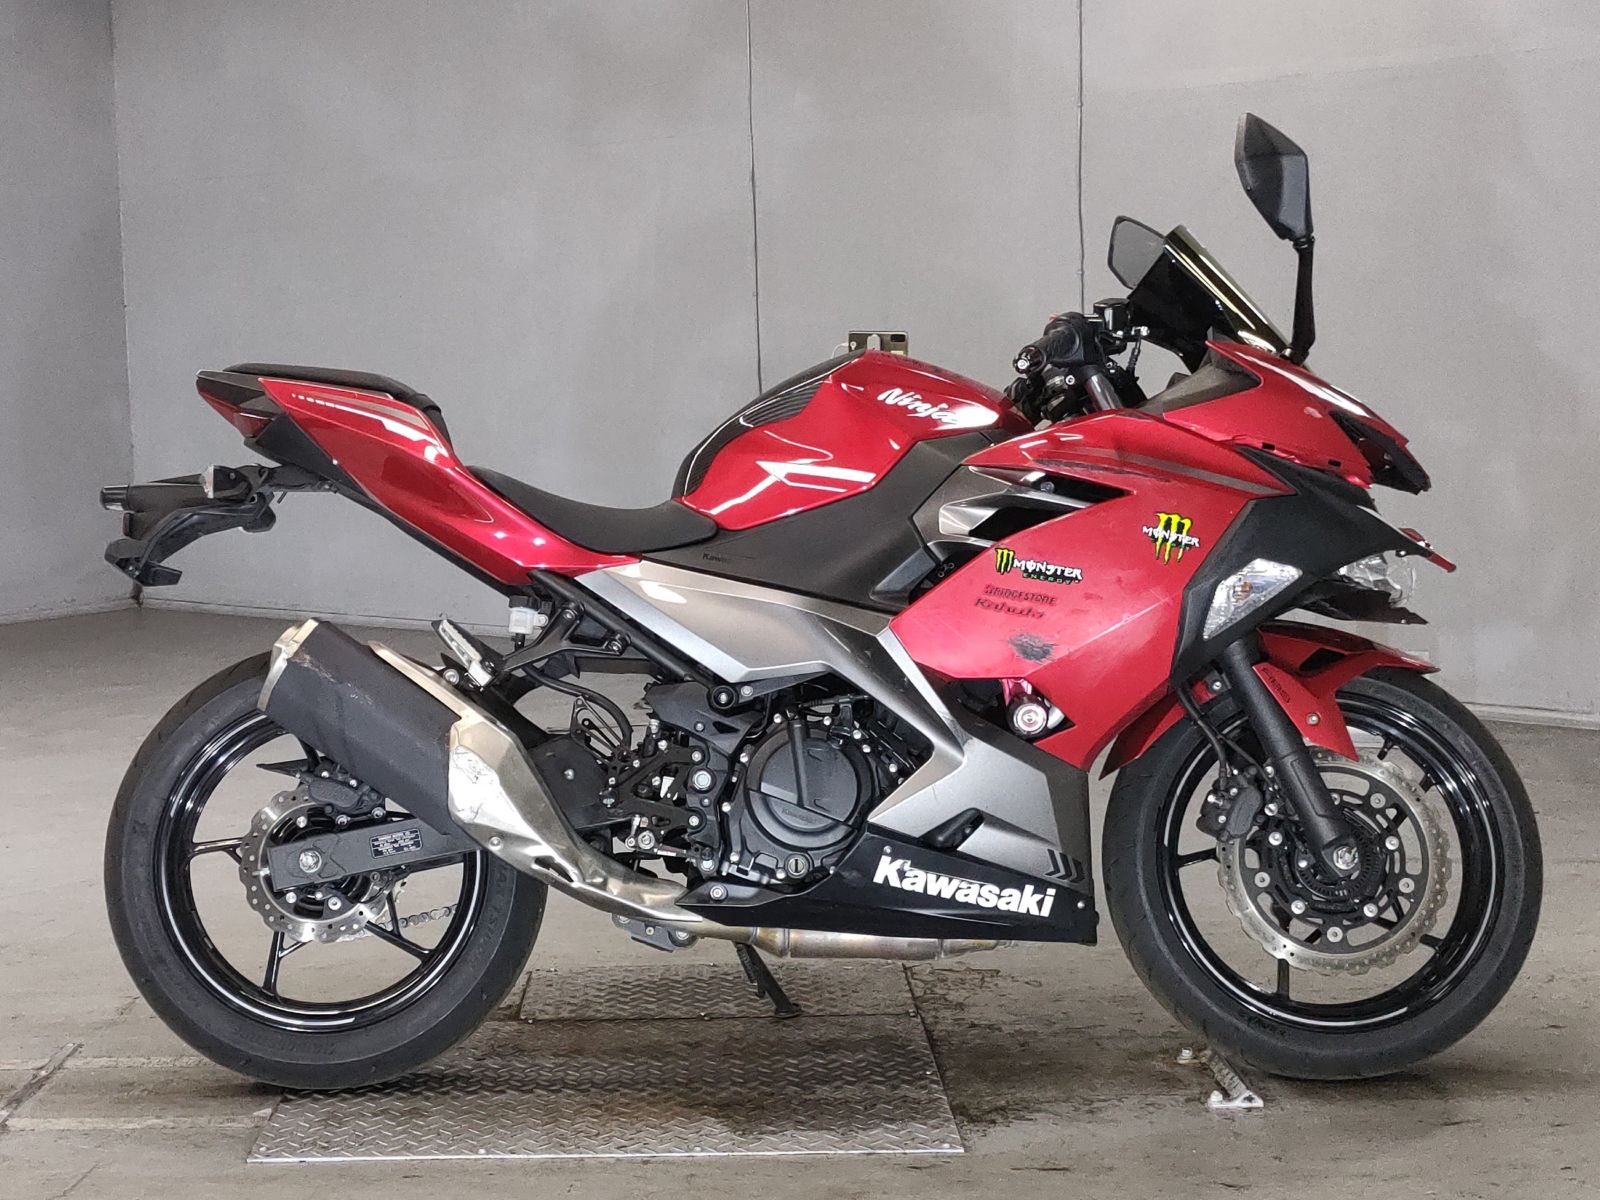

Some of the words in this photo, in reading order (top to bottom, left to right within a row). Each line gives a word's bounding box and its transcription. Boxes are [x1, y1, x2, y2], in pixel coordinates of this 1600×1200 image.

[877, 388, 958, 424] Ninja
[1013, 558, 1083, 581] MONSTER
[873, 855, 1056, 918] Kawasaki
